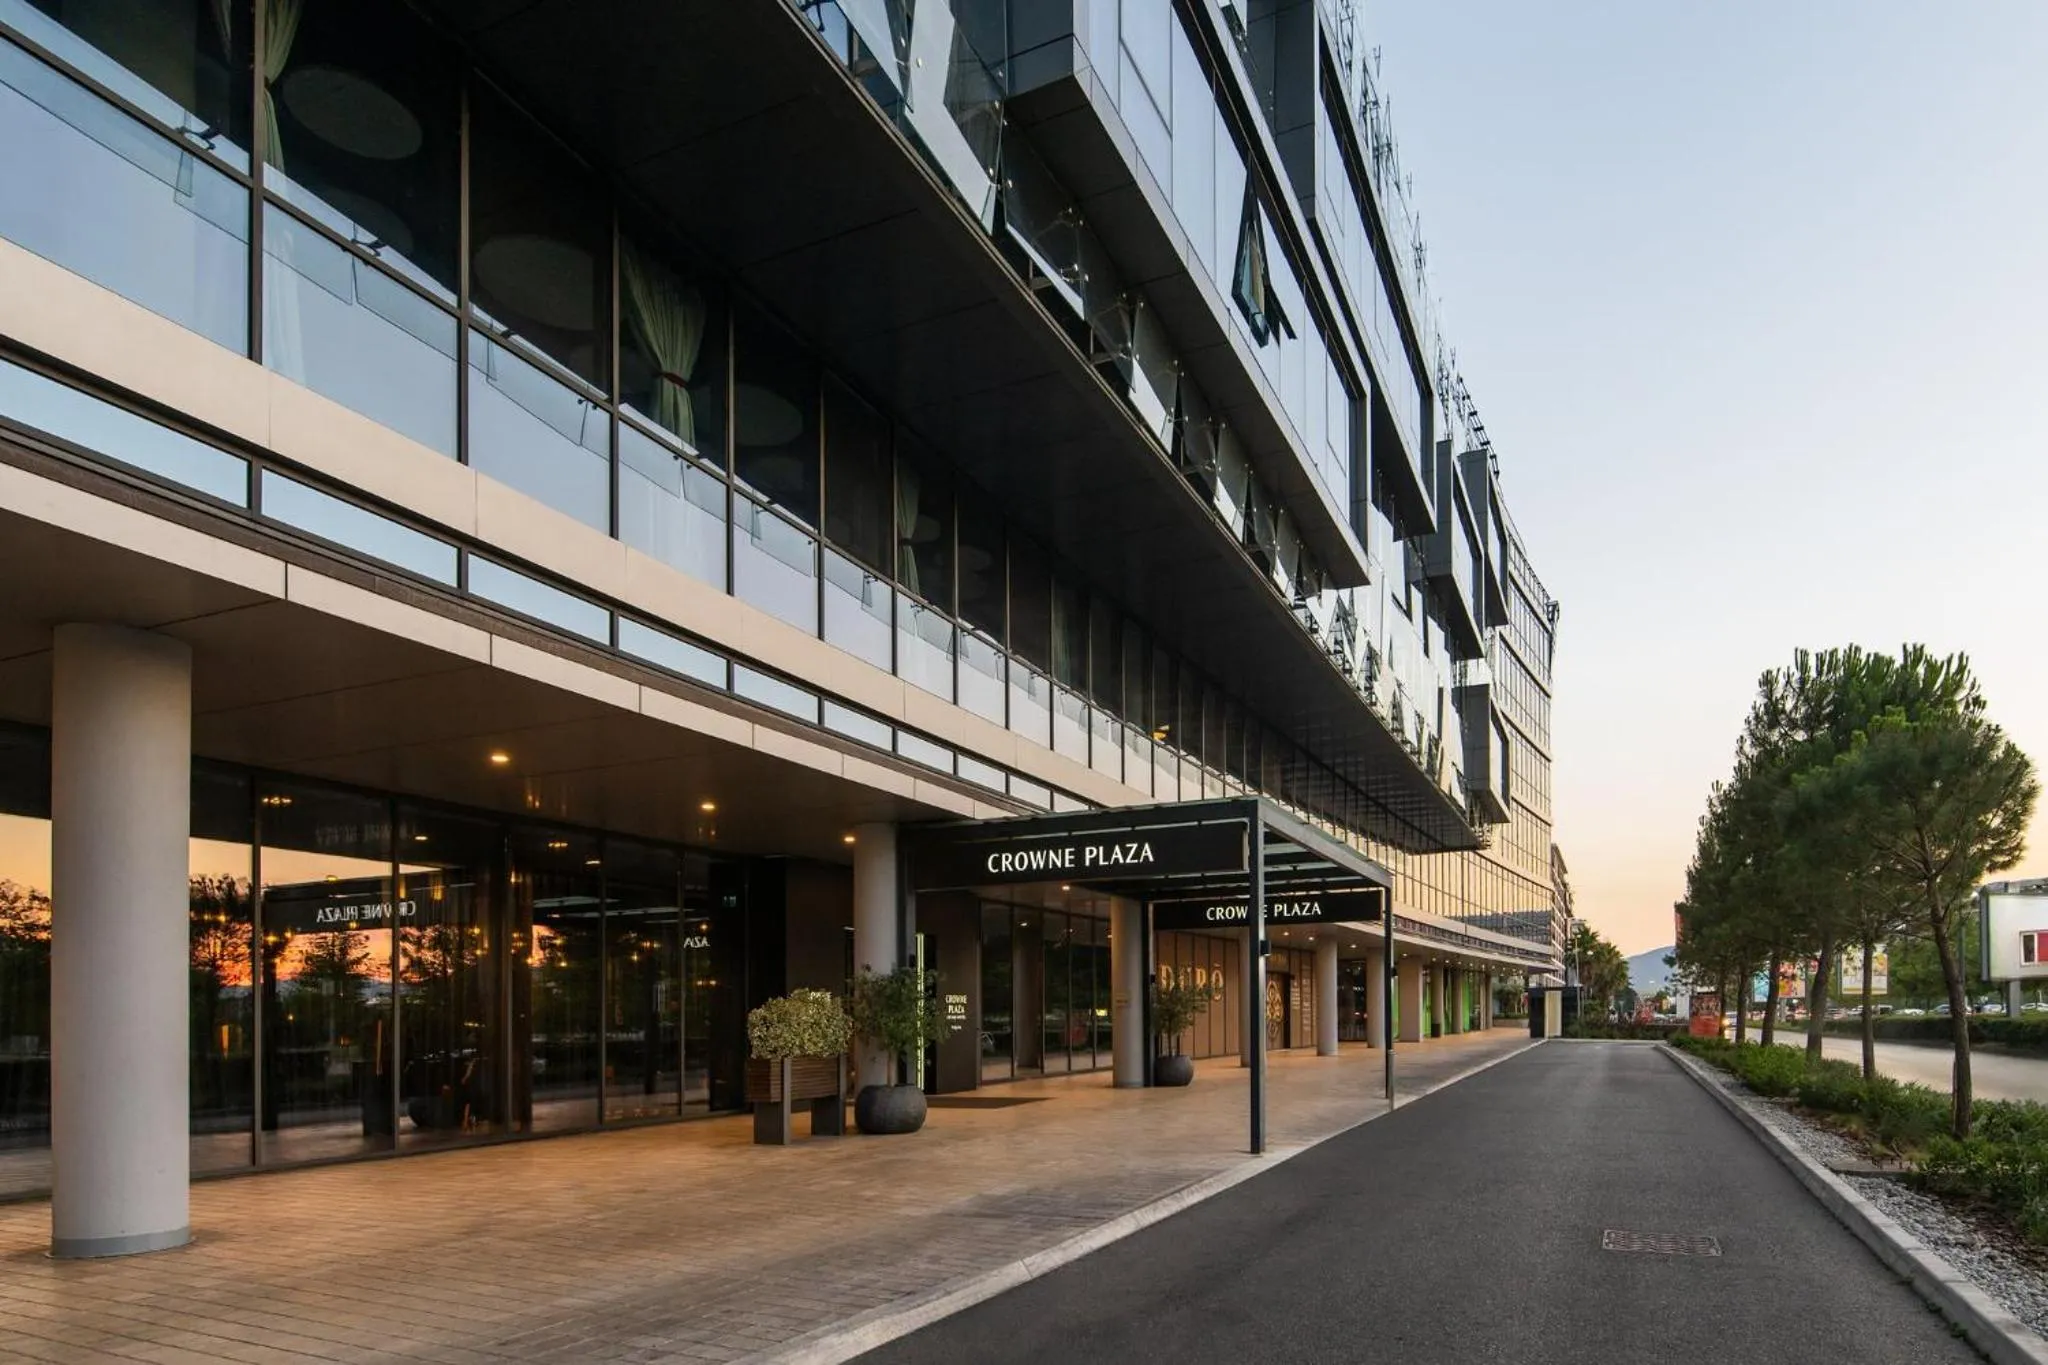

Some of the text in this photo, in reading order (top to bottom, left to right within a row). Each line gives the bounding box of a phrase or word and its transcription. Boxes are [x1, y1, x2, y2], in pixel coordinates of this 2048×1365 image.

[987, 842, 1155, 873] CROWNE PLAZA
[1274, 901, 1322, 917] PLAZA
